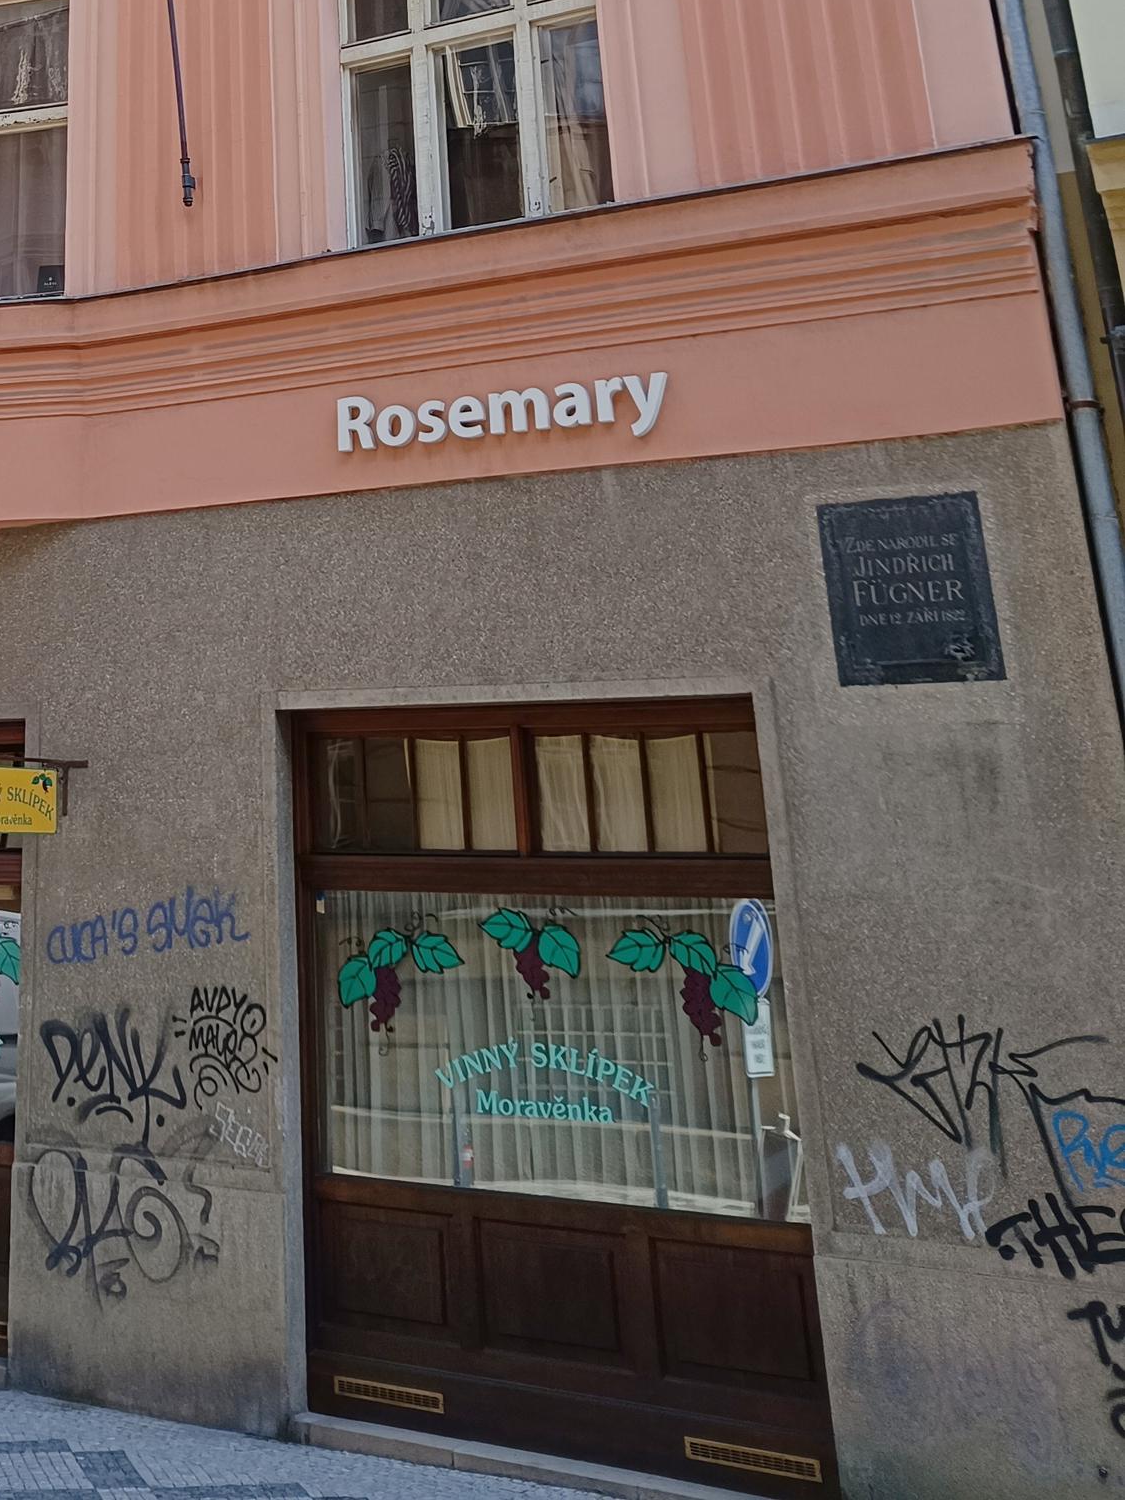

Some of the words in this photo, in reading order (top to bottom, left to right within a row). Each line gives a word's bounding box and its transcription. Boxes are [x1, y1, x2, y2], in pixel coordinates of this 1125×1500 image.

[337, 371, 668, 452] Rosemary
[854, 553, 954, 577] JINDŘICH
[852, 579, 964, 607] FÜGNER
[7, 786, 54, 820] SKLÍPEK
[434, 1036, 519, 1089] VINNÝ
[530, 1041, 655, 1108] SKLÍPEK
[475, 1088, 616, 1124] Moravěnka
